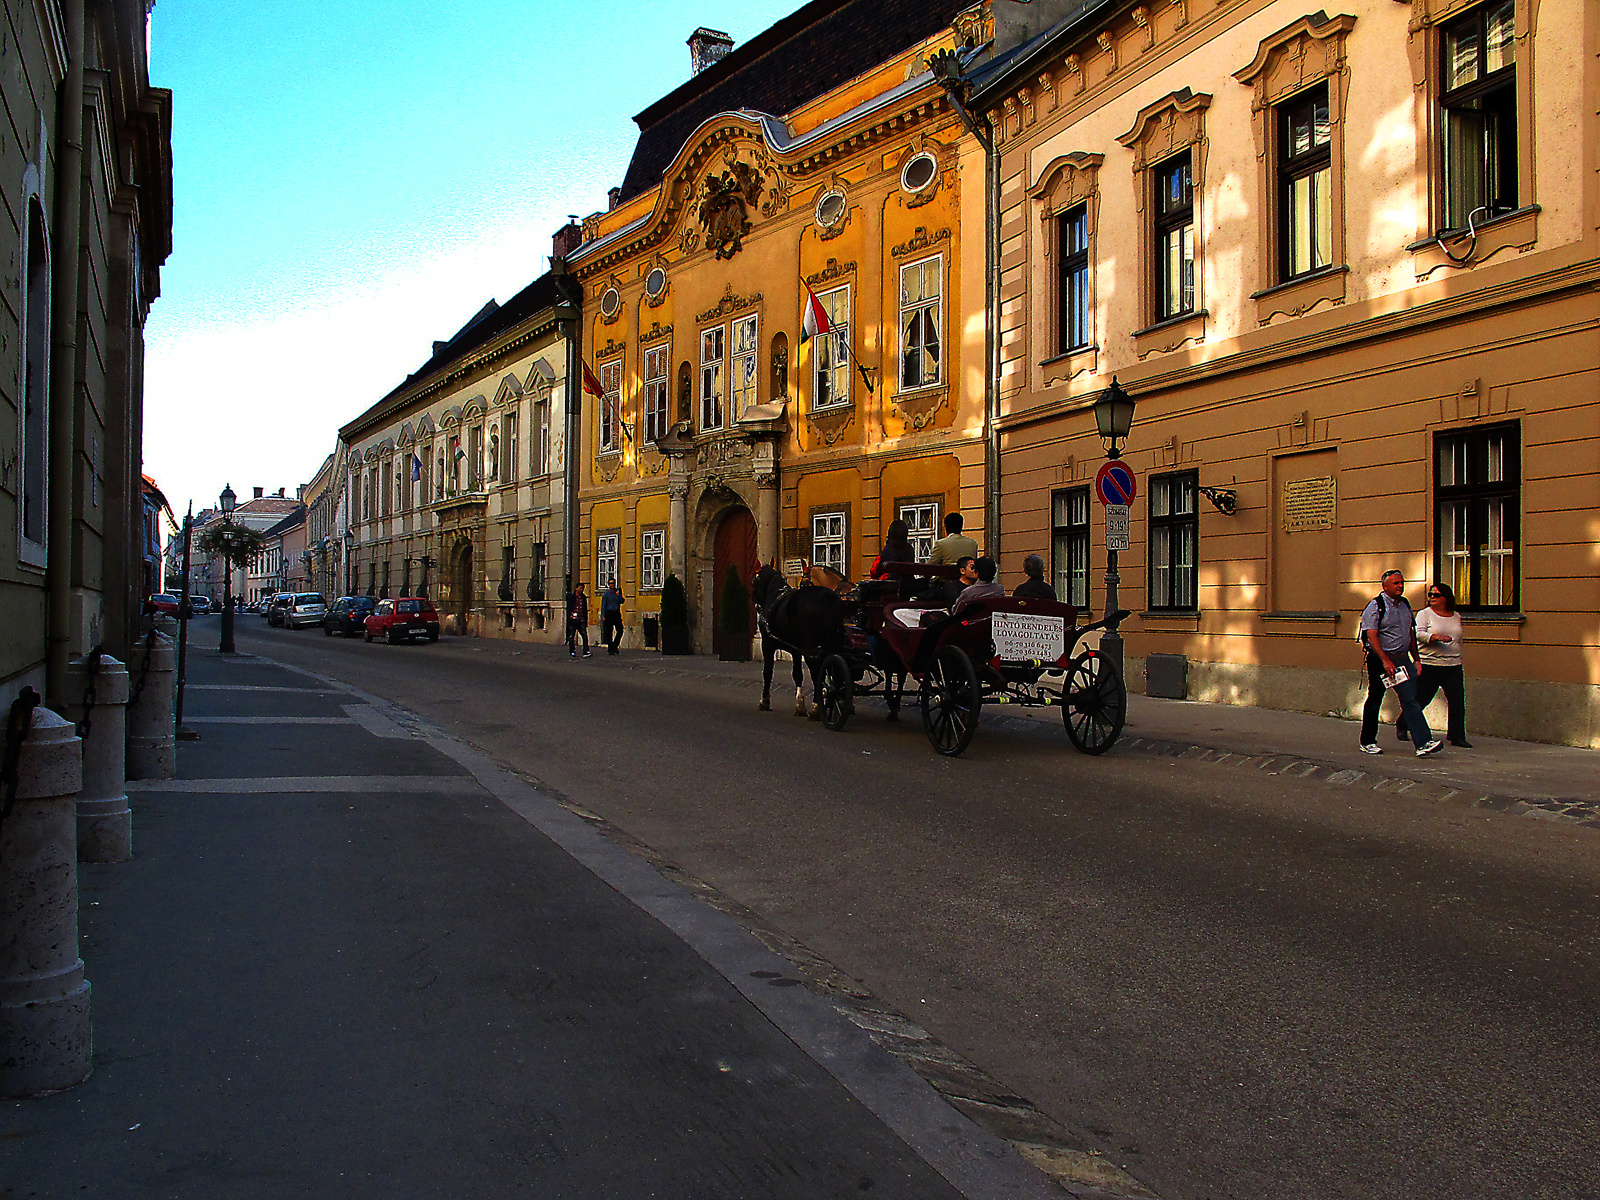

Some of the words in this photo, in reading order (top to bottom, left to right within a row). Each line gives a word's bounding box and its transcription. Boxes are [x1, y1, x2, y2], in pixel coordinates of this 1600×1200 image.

[994, 620, 1021, 629] HINTÓ
[1021, 622, 1063, 633] RENDELÉS
[996, 629, 1060, 641] LOVAGOLTATÁS
[1004, 640, 1023, 648] 06-70
